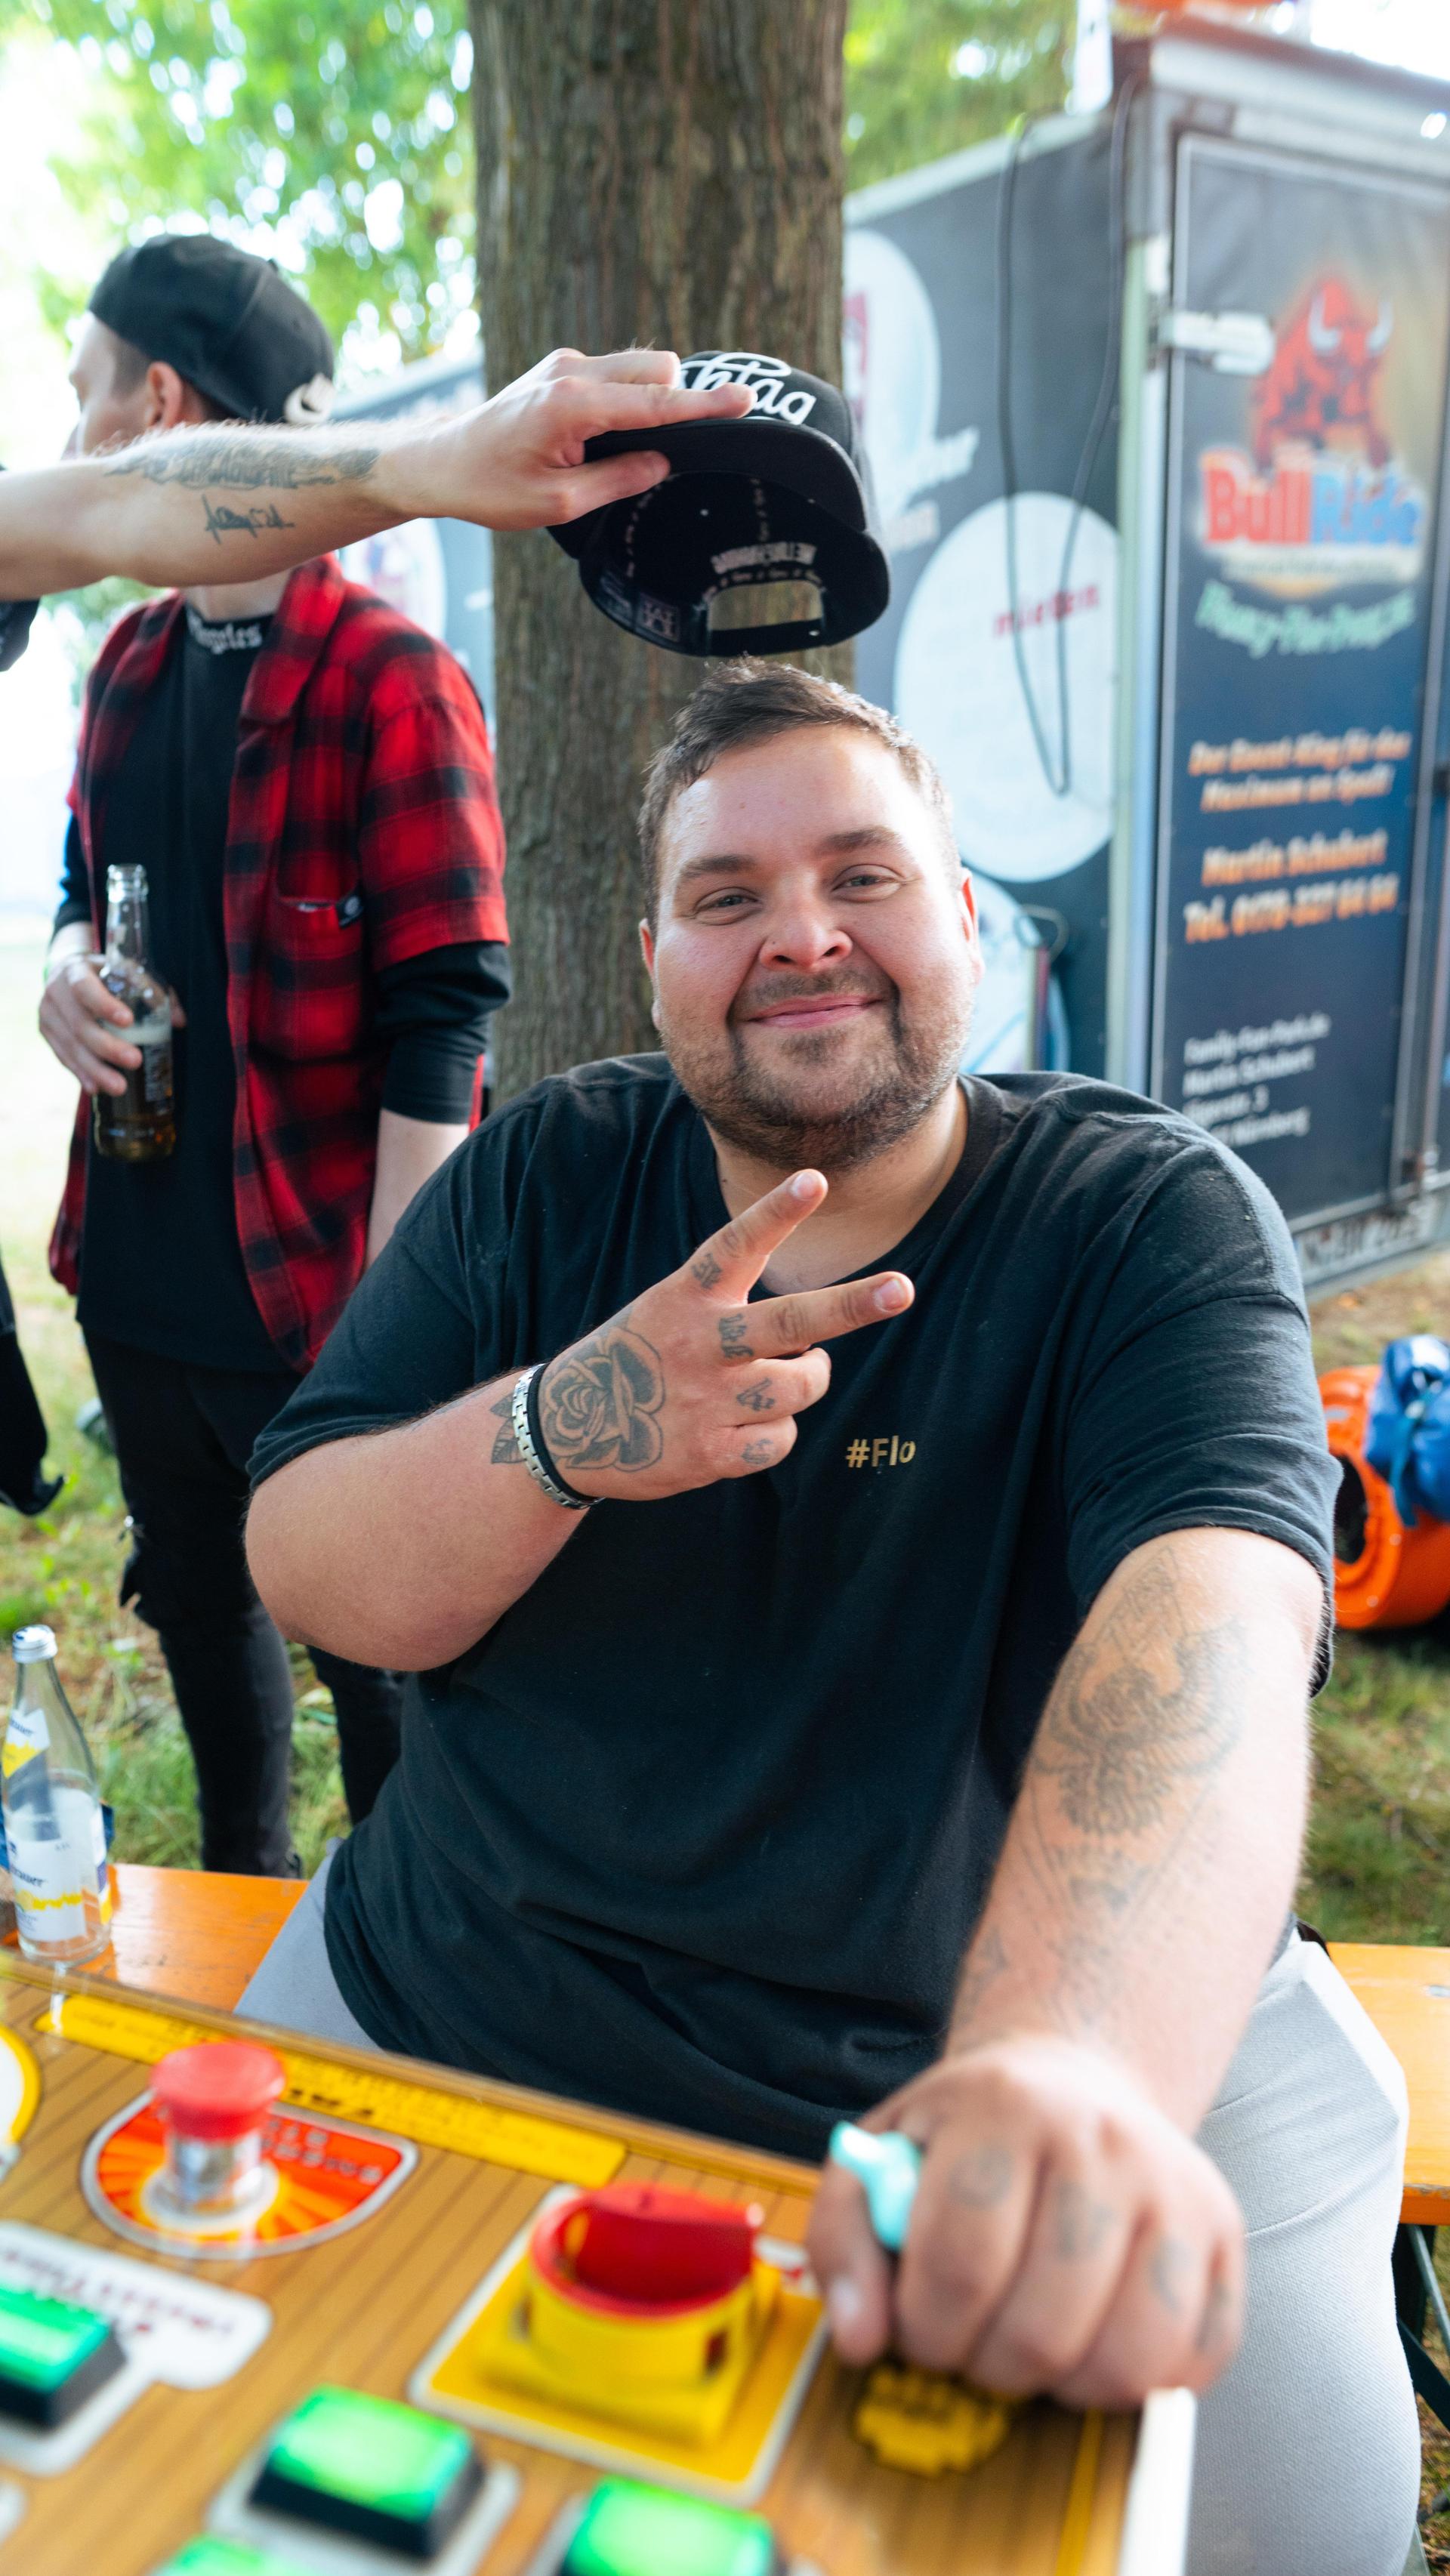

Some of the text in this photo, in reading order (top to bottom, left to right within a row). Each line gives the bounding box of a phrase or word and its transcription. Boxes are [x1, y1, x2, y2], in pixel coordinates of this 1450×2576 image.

[1201, 452, 1420, 548] BullRide
[1201, 828, 1388, 887] Martin Schubert
[1183, 894, 1229, 943] Tel.
[1239, 1044, 1316, 1086] Schubert
[845, 1435, 916, 1468] #Flo
